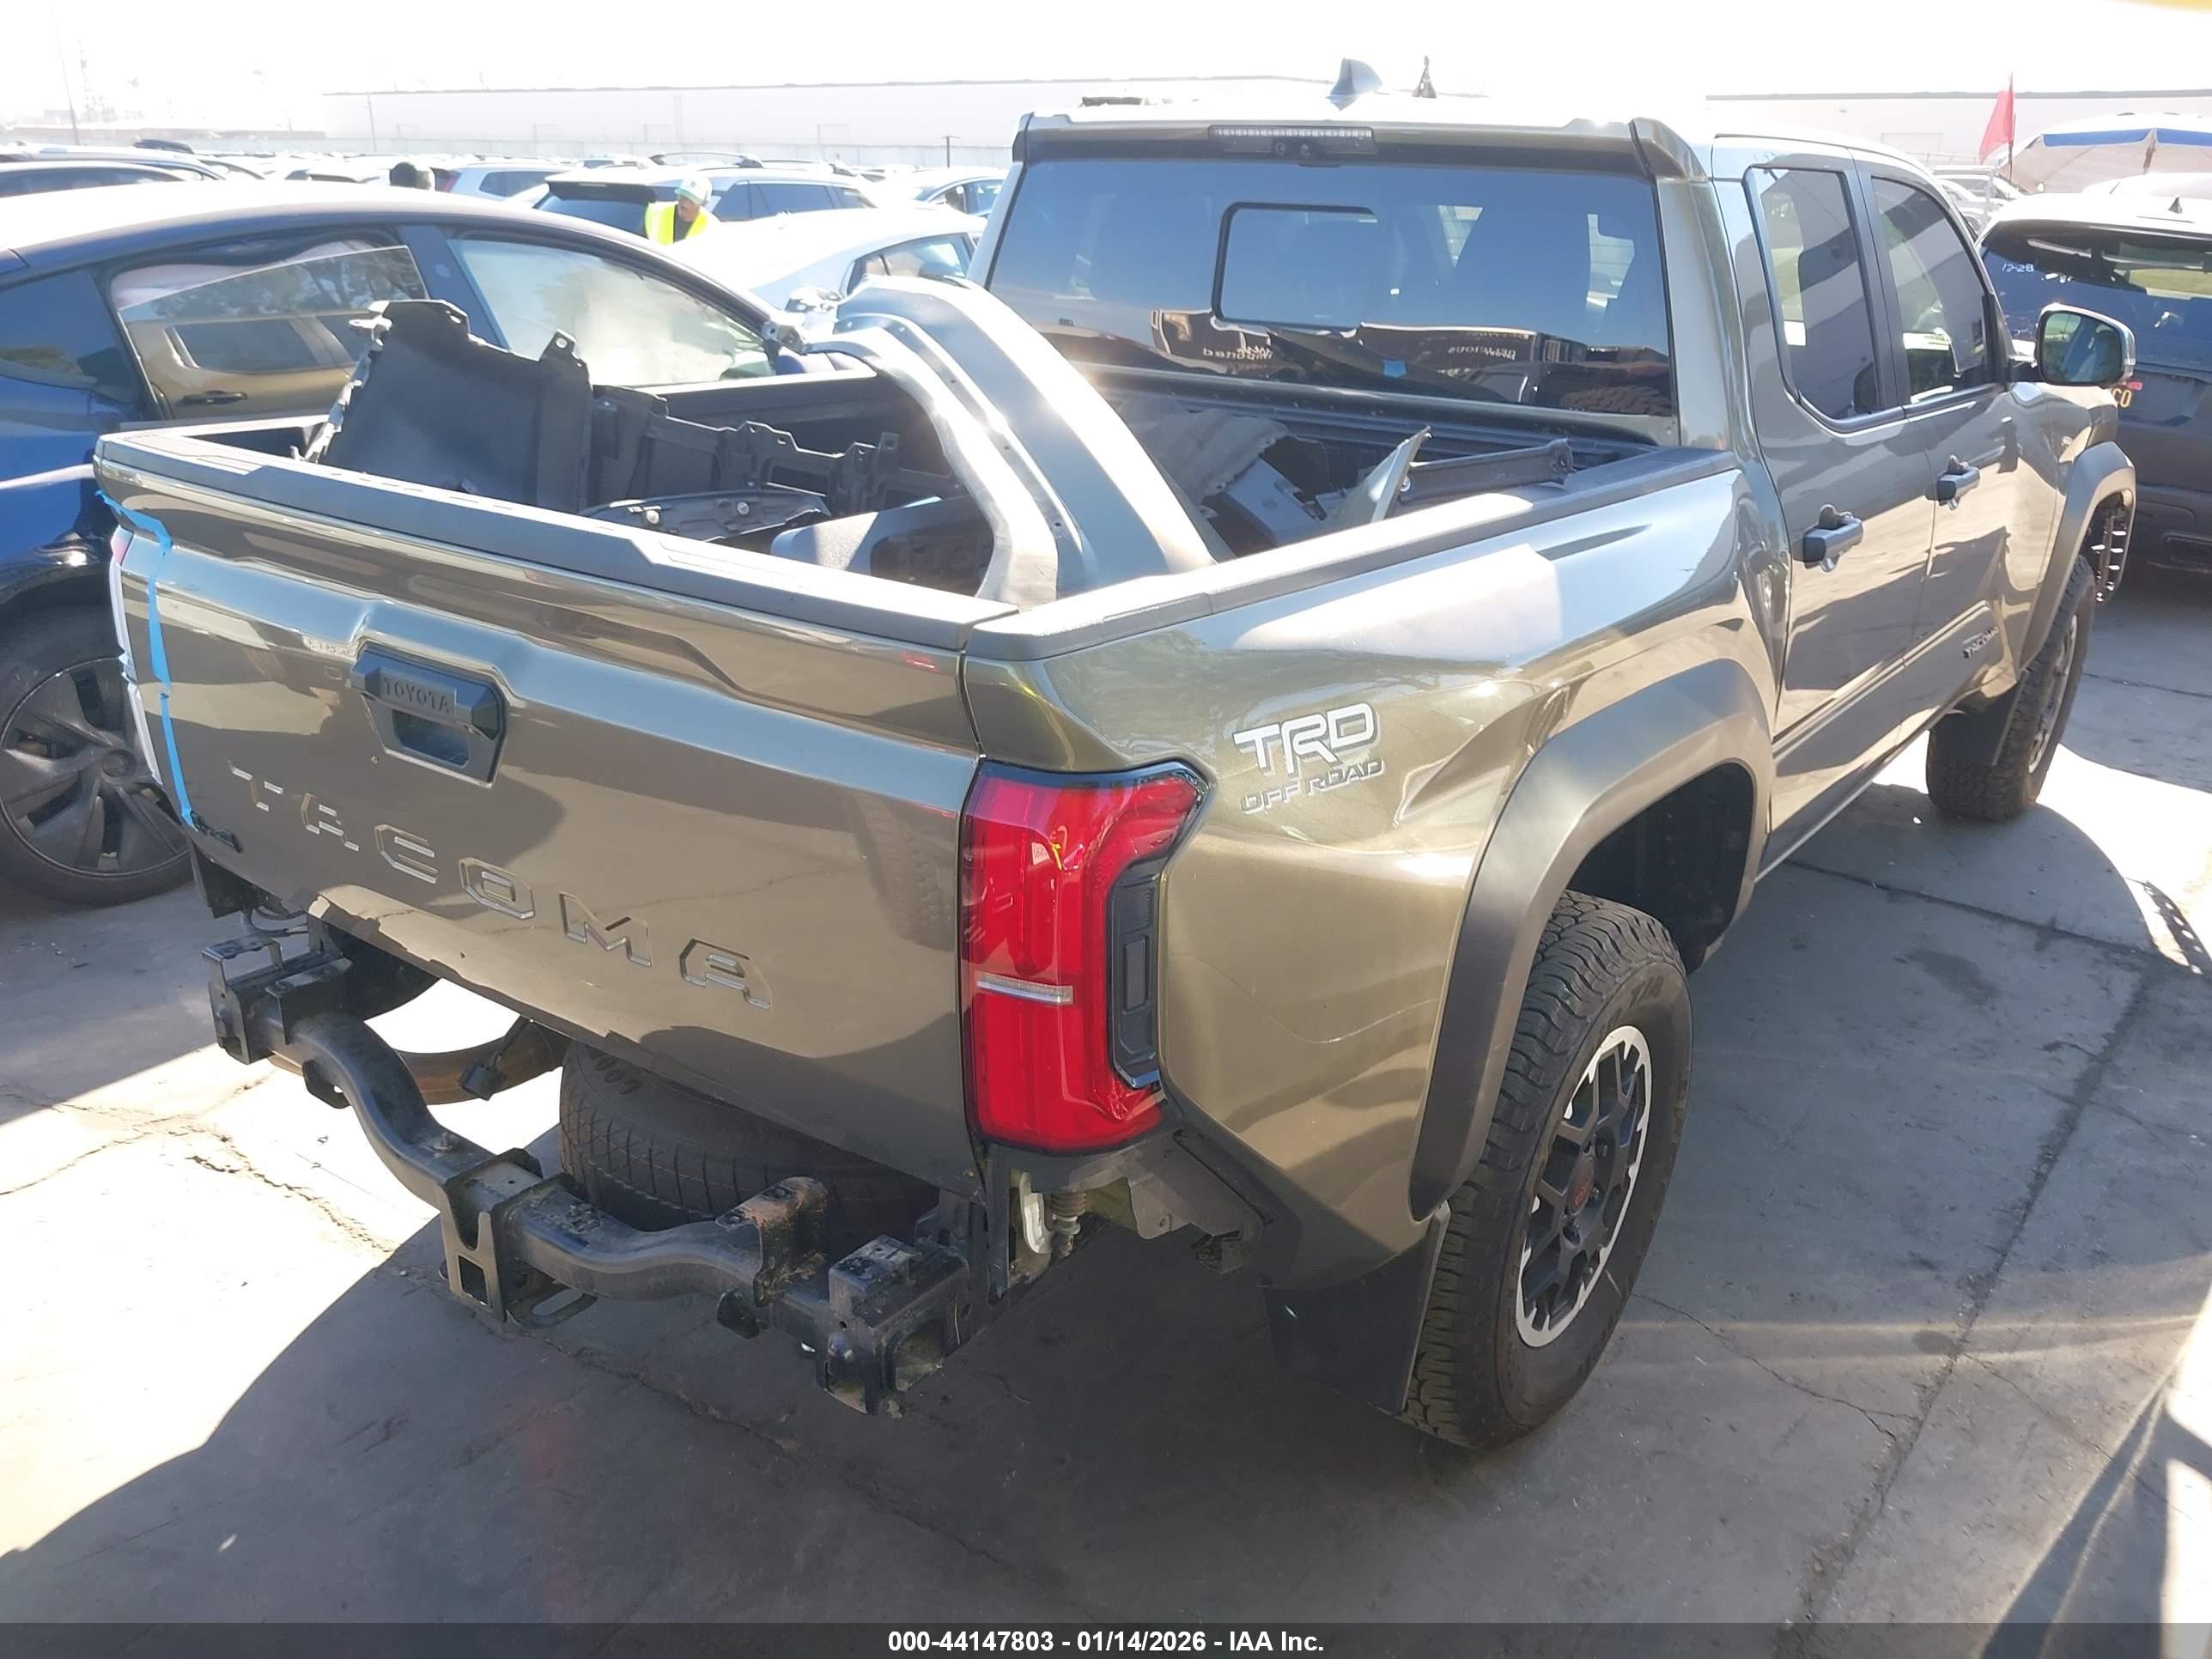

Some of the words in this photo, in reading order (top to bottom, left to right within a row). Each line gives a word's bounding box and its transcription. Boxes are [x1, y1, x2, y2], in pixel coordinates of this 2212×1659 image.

[384, 677, 449, 714] TOYOTA
[1233, 702, 1381, 777] TRD
[1241, 782, 1302, 814] OFF
[1305, 758, 1386, 796] ROAD
[228, 759, 772, 1010] TACOMA
